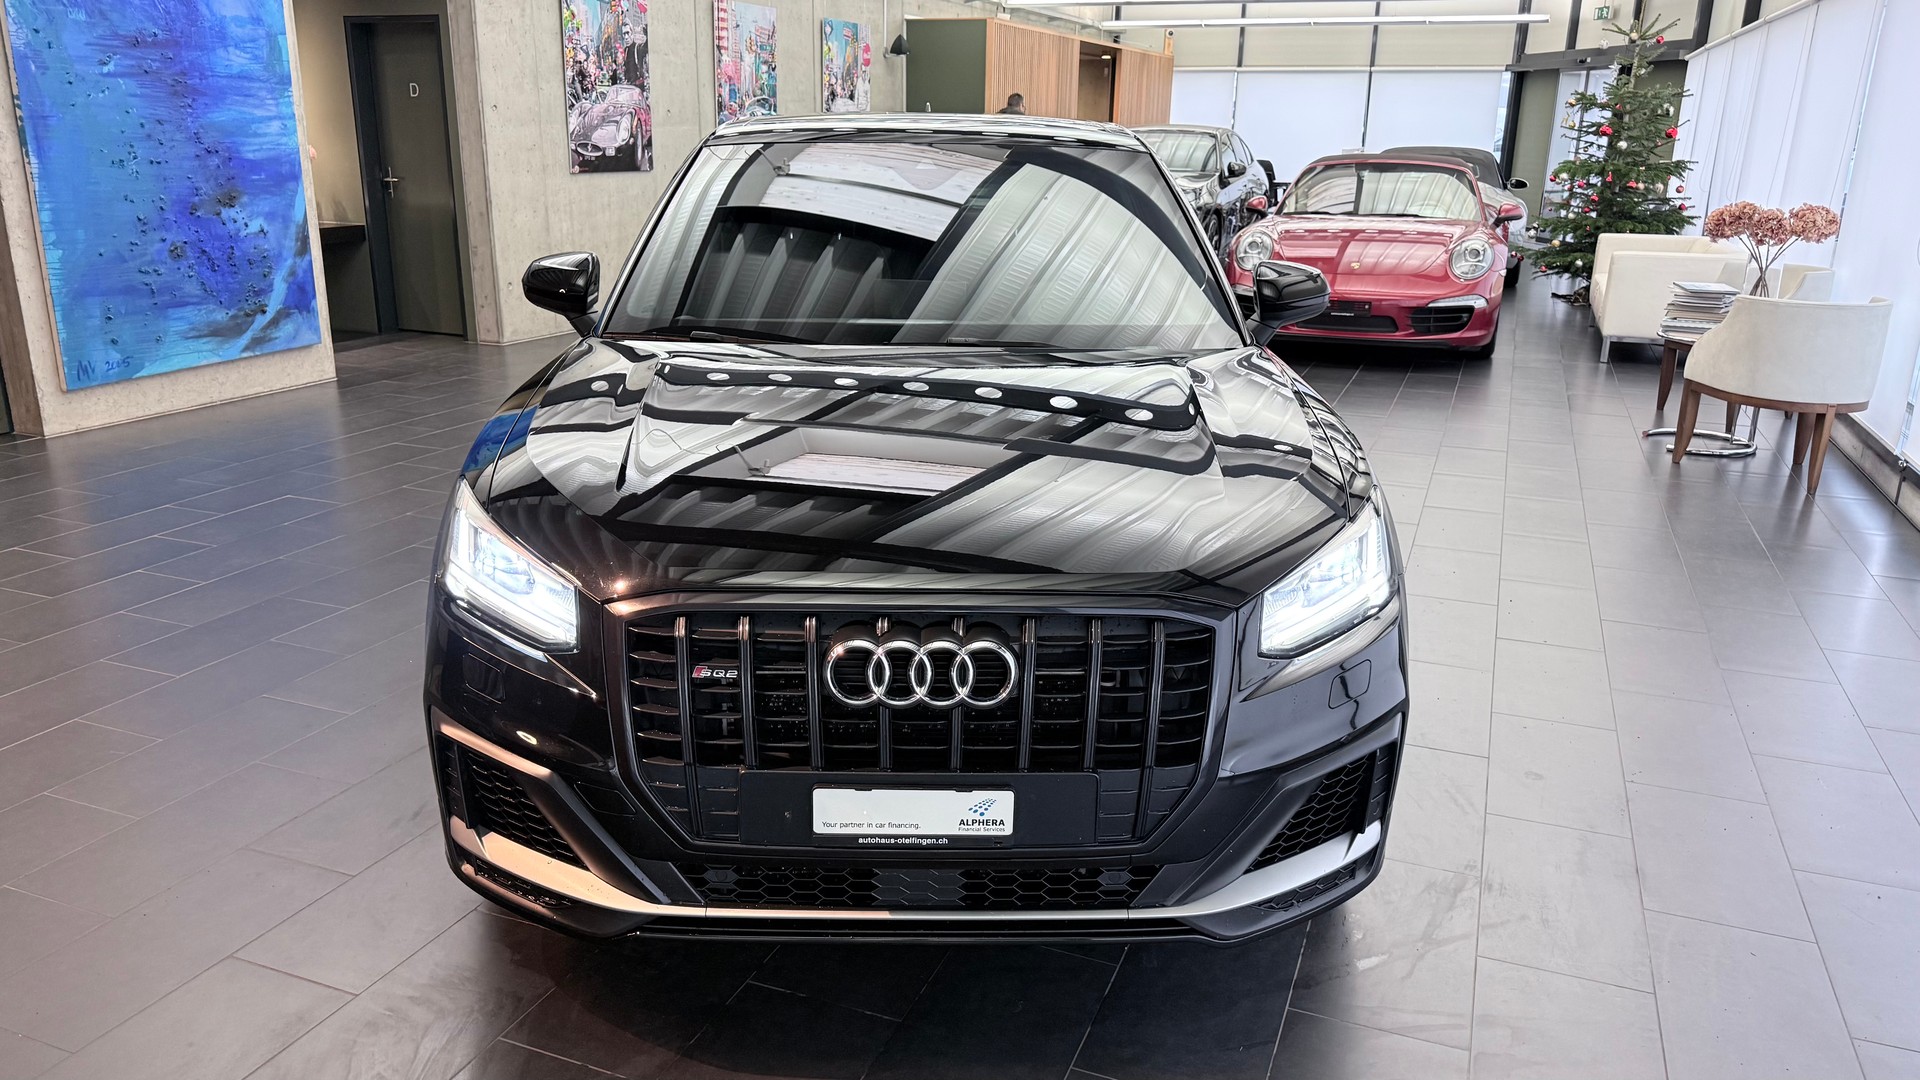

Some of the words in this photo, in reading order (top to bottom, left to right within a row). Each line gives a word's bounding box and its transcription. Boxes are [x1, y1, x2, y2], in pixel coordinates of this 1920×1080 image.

[409, 82, 420, 97] D
[700, 669, 738, 678] SQ2
[839, 821, 865, 829] partner
[888, 821, 922, 830] financing.
[958, 818, 1006, 827] ALPHERA
[857, 836, 949, 846] autohaus-otelfingen.ch
